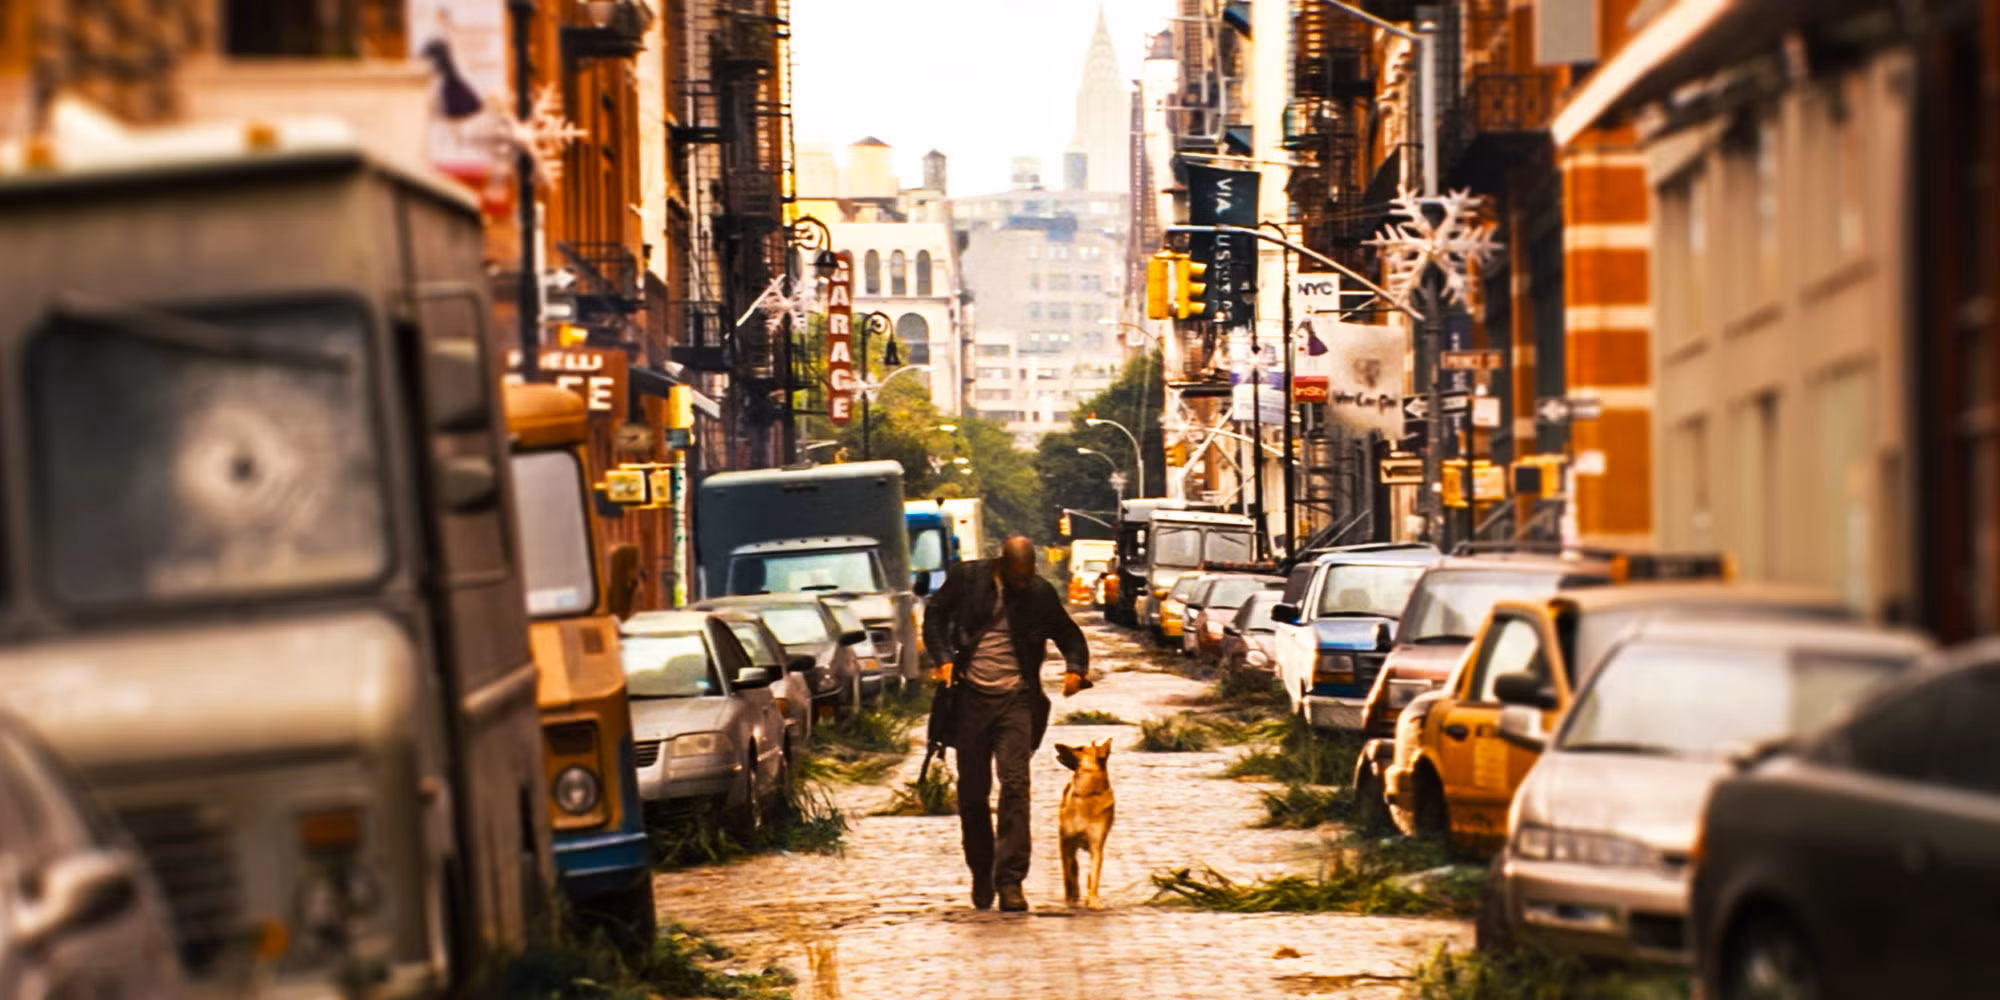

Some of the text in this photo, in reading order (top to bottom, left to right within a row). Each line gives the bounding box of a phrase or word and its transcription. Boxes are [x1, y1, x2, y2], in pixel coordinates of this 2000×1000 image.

[1215, 177, 1233, 216] VIA
[1297, 281, 1333, 296] NYC
[829, 256, 850, 419] GARAGE
